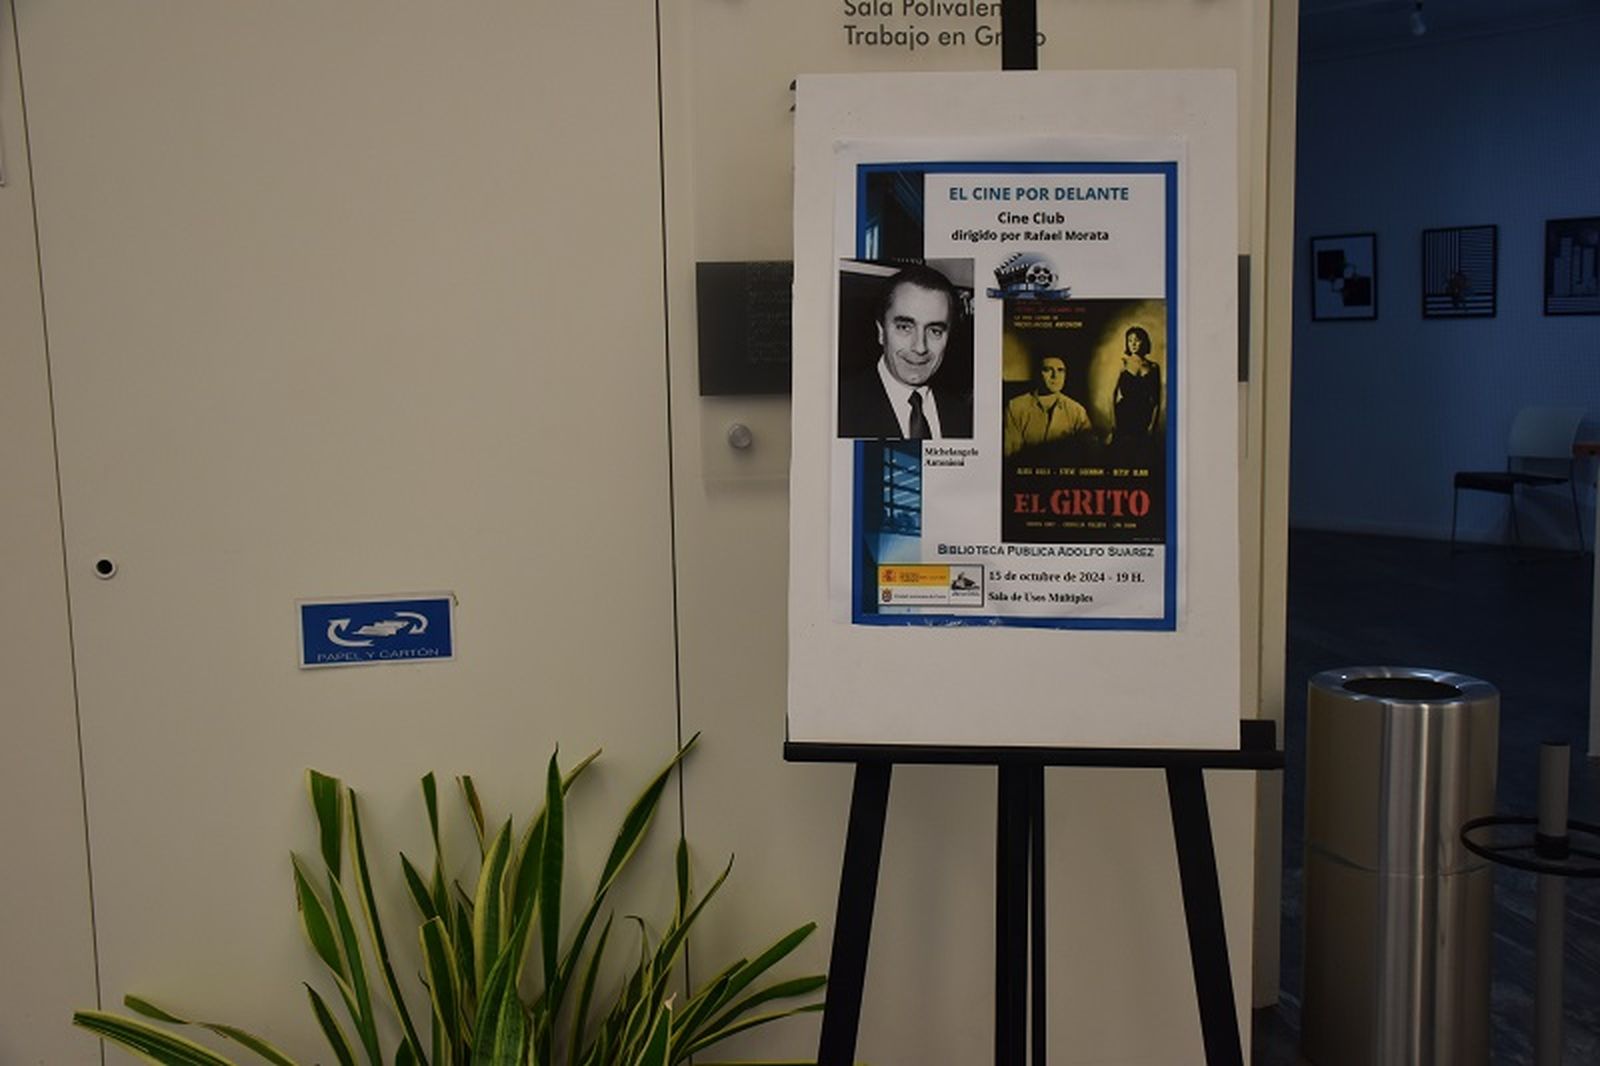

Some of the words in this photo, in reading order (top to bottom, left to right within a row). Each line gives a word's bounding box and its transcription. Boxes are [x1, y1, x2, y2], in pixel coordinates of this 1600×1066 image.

[844, 0, 893, 16] Sala
[903, 0, 1002, 17] Polivalen
[843, 24, 929, 50] Trabajo
[938, 31, 965, 46] en
[975, 25, 1047, 47] Gro
[949, 187, 967, 201] EL
[973, 187, 1011, 201] CINE
[1016, 187, 1049, 201] POR
[1055, 187, 1129, 201] DELANTE
[997, 212, 1029, 224] Cine
[1033, 212, 1065, 224] Club
[951, 230, 997, 243] dirigido
[1000, 232, 1021, 243] por
[1024, 231, 1062, 241] Rafael
[1065, 231, 1109, 241] Morata
[1013, 493, 1046, 513] EL
[1050, 488, 1151, 517] GRITO
[937, 543, 1005, 555] BIBLIOTECA
[1057, 546, 1104, 557] ADOLFO
[989, 571, 1001, 581] 15
[1004, 571, 1016, 581] de
[1019, 571, 1061, 582] octubre
[1063, 572, 1077, 582] de
[1079, 572, 1105, 583] 2024
[1116, 572, 1129, 583] 19
[1131, 572, 1145, 583] H.
[988, 592, 1008, 601] Sala
[1011, 592, 1022, 601] de
[317, 651, 362, 661] PAPEL
[366, 651, 375, 659] Y
[380, 647, 439, 659] CARTÓN
